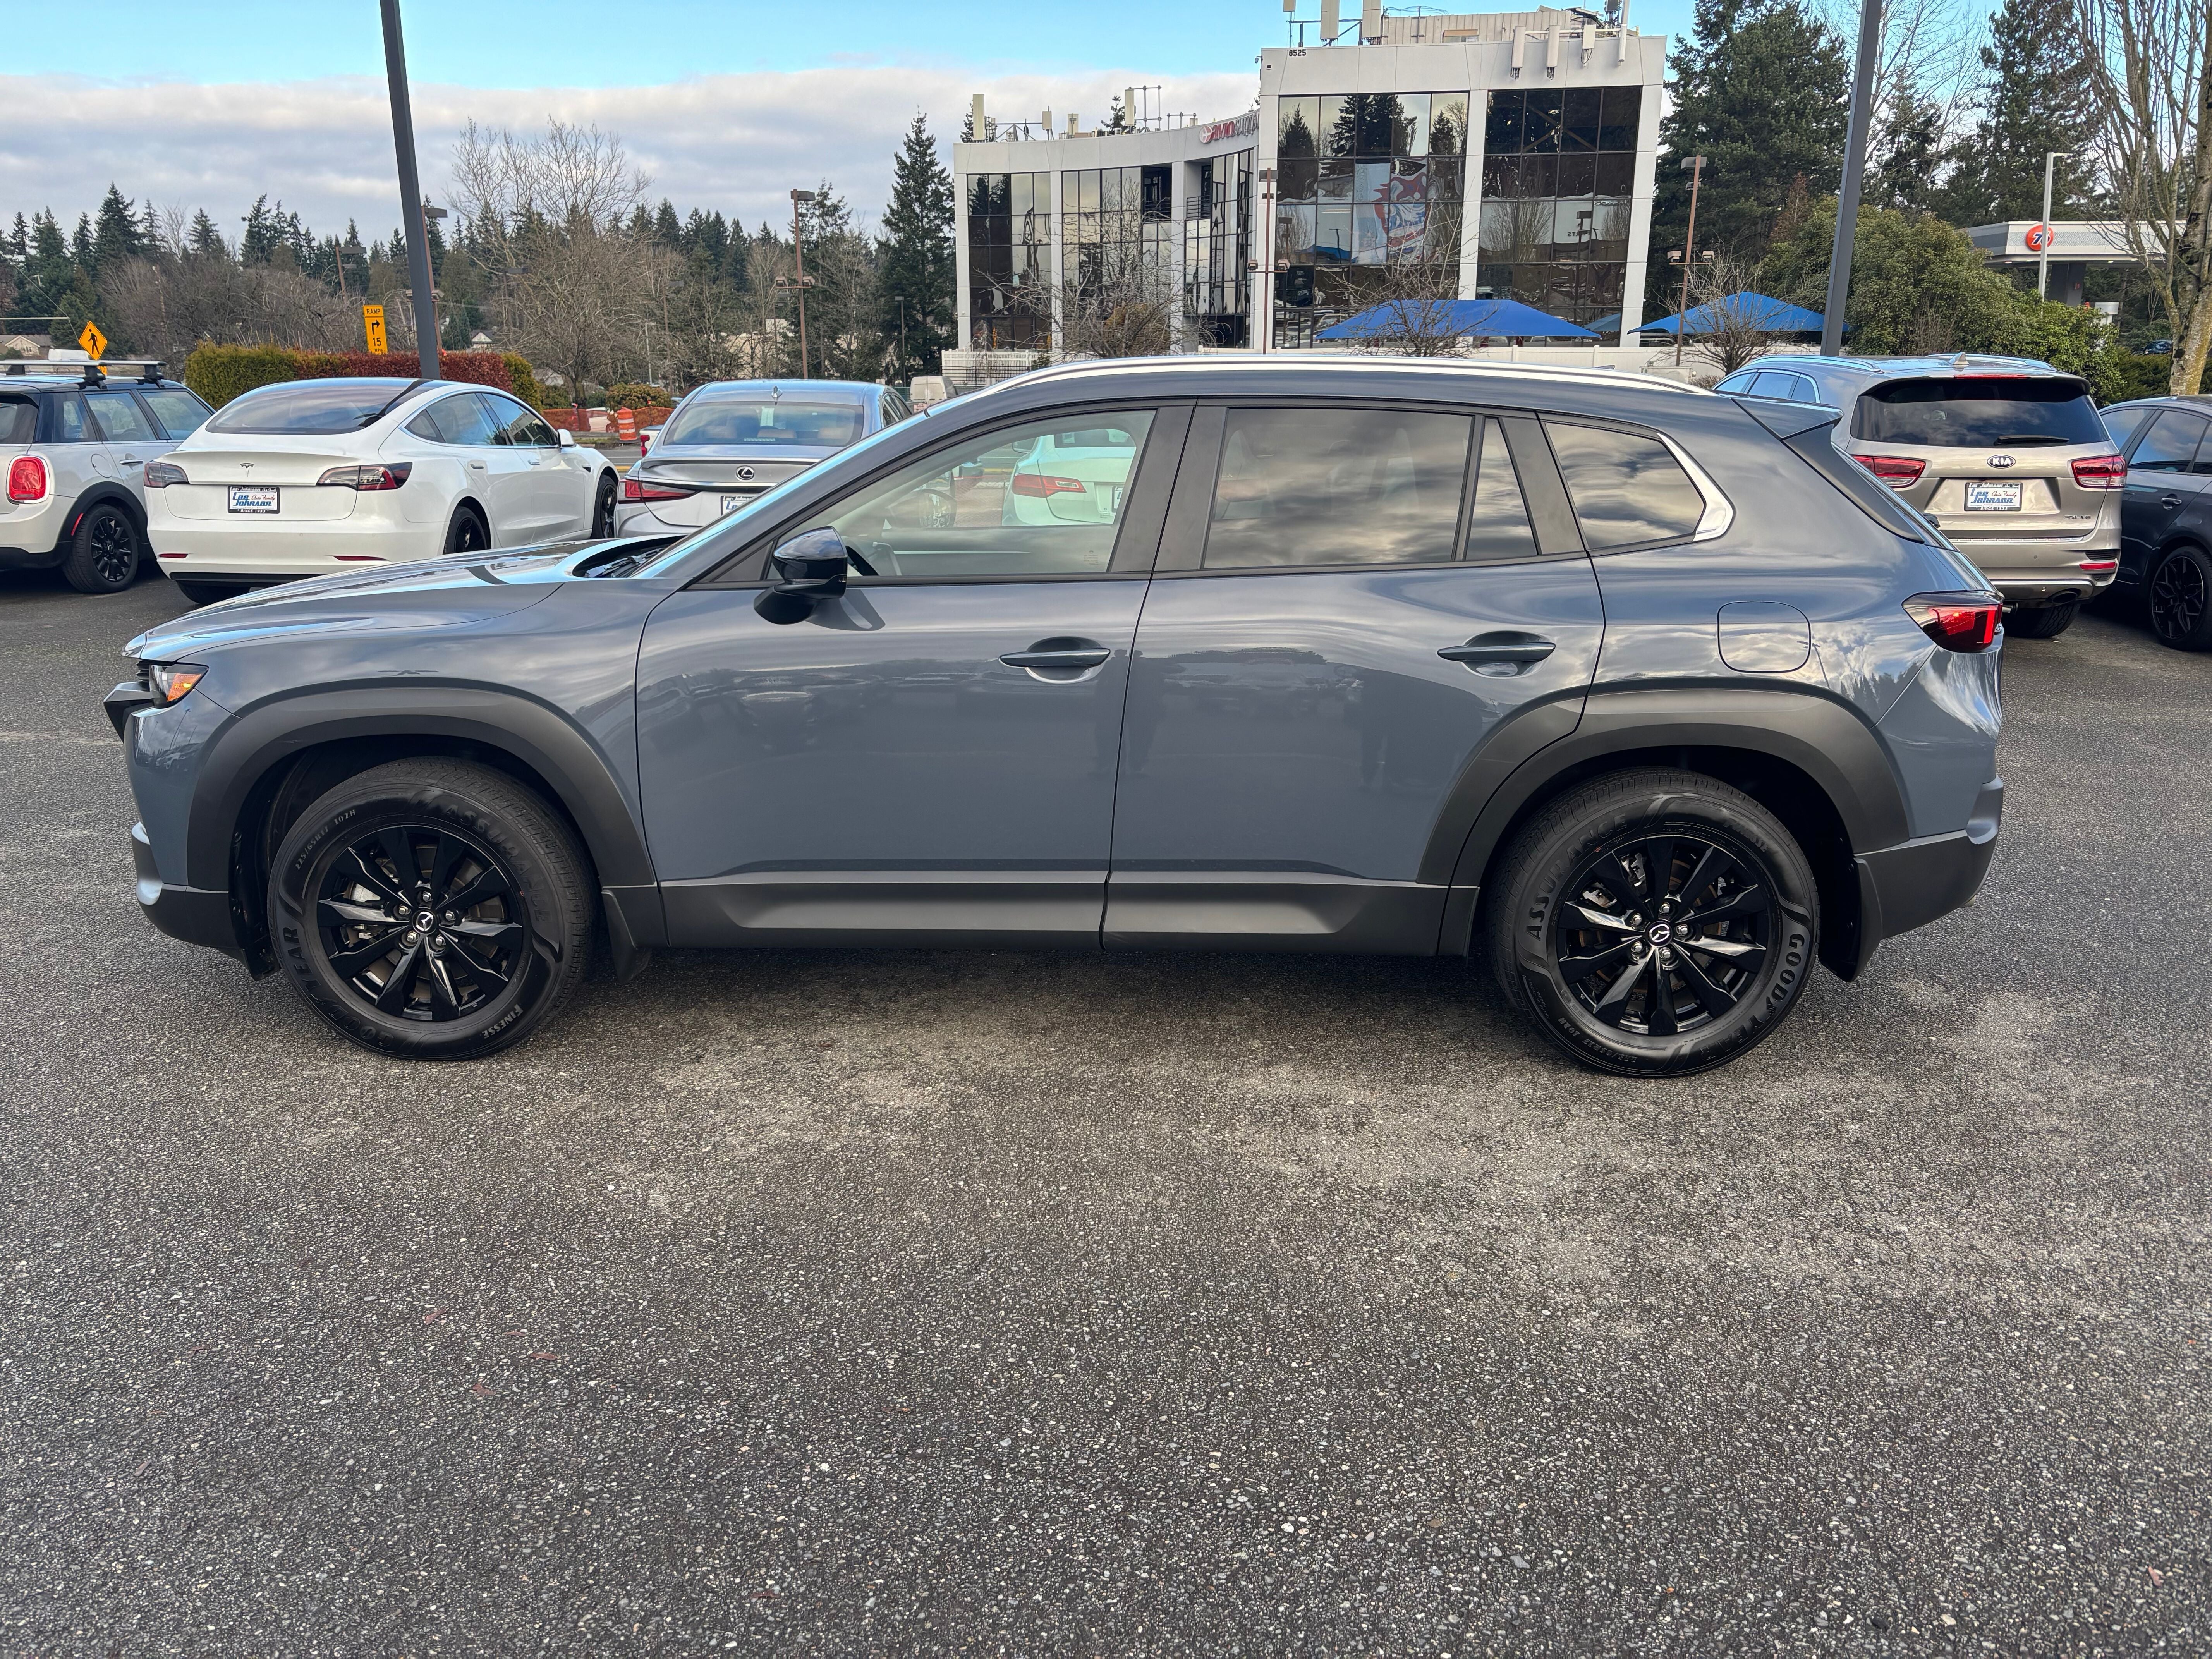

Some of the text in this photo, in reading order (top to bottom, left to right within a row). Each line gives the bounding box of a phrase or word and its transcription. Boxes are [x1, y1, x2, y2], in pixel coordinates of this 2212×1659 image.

[373, 337, 381, 347] 15
[232, 492, 250, 500] Lee
[1970, 488, 1989, 496] Lee
[295, 809, 356, 871] 225/65R17 102H
[445, 804, 549, 922] ASSURANCE
[1526, 813, 1628, 941] ASSURANCE
[283, 927, 394, 1047] GOODYEAR
[1699, 933, 1805, 1061] GOODYEAR
[482, 1003, 523, 1039] FINESSE
[1558, 1017, 1580, 1037] 102H
